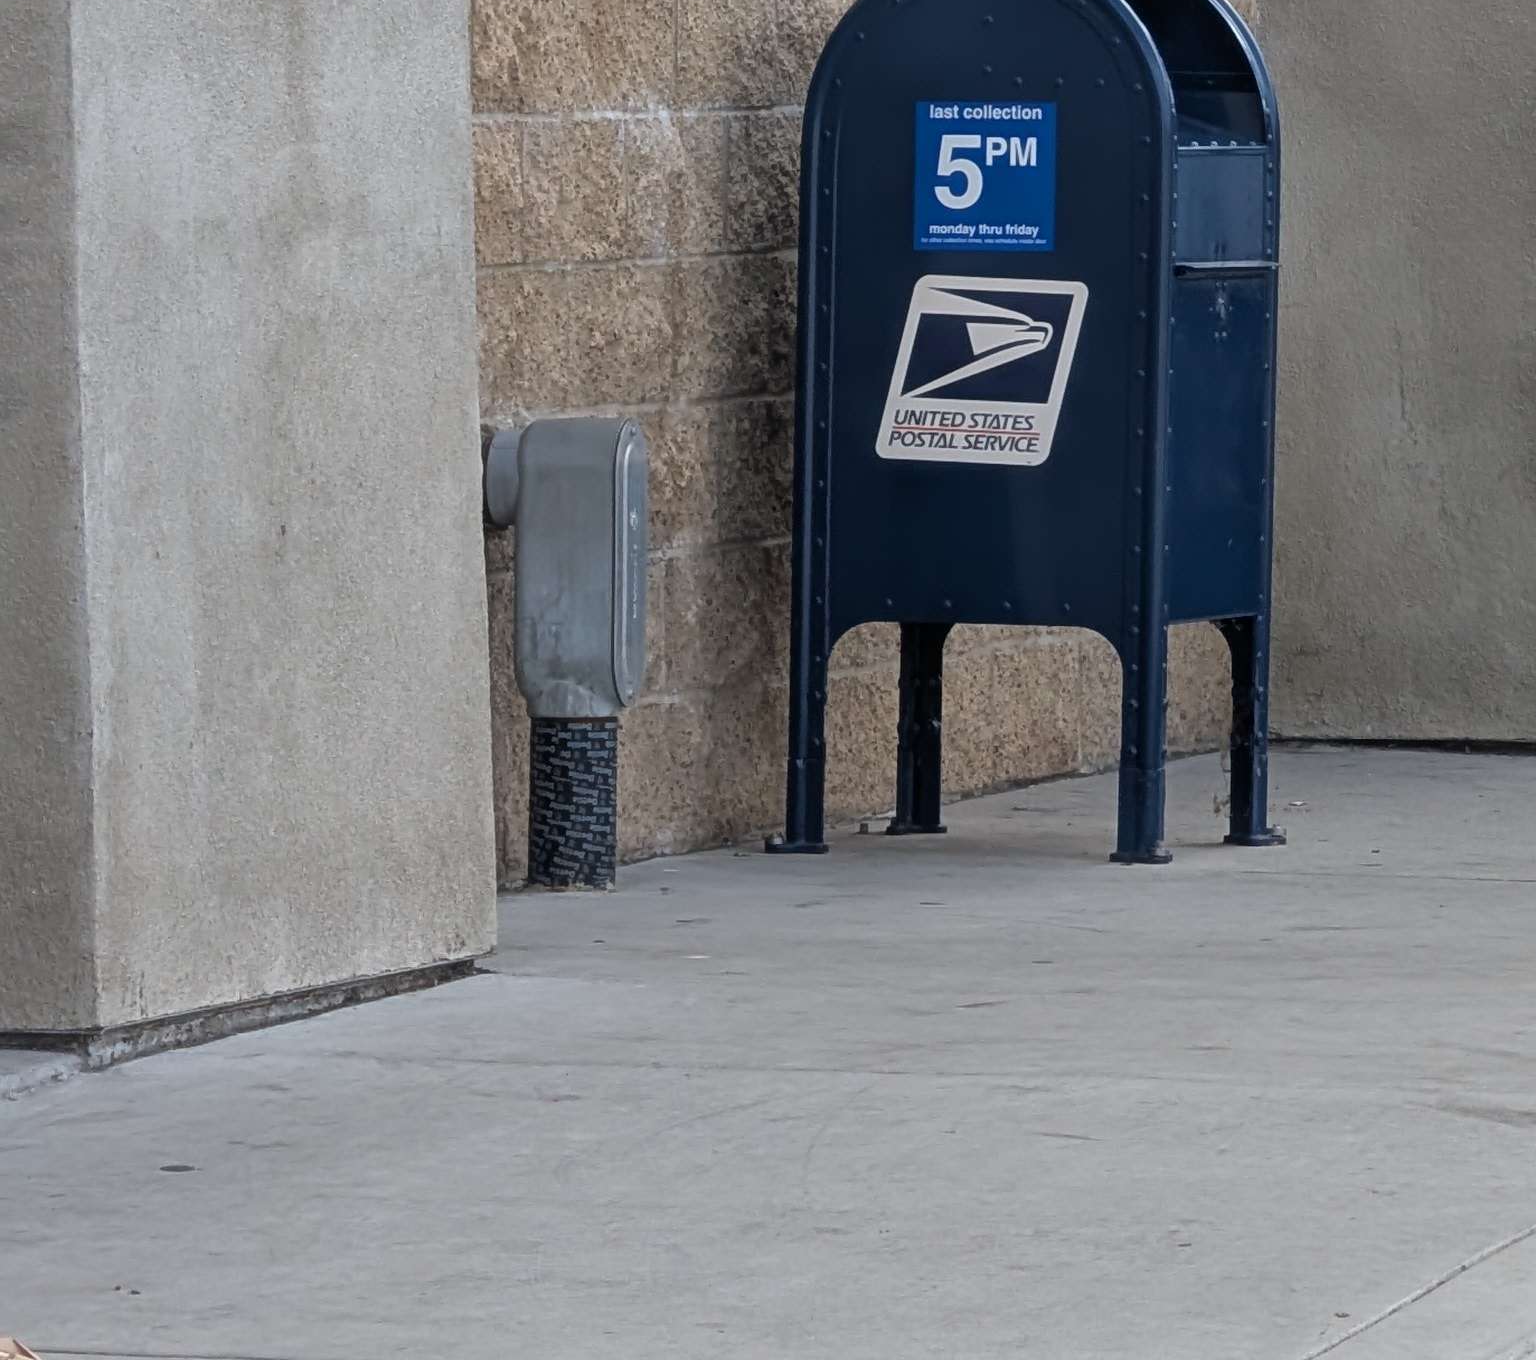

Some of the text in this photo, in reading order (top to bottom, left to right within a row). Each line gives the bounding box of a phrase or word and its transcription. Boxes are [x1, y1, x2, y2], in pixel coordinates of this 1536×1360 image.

[929, 104, 1042, 120] last collection
[929, 223, 1039, 238] monday thru friday
[894, 409, 1035, 431] UNITED STATES
[888, 431, 1040, 453] POSTAL SERVICE
